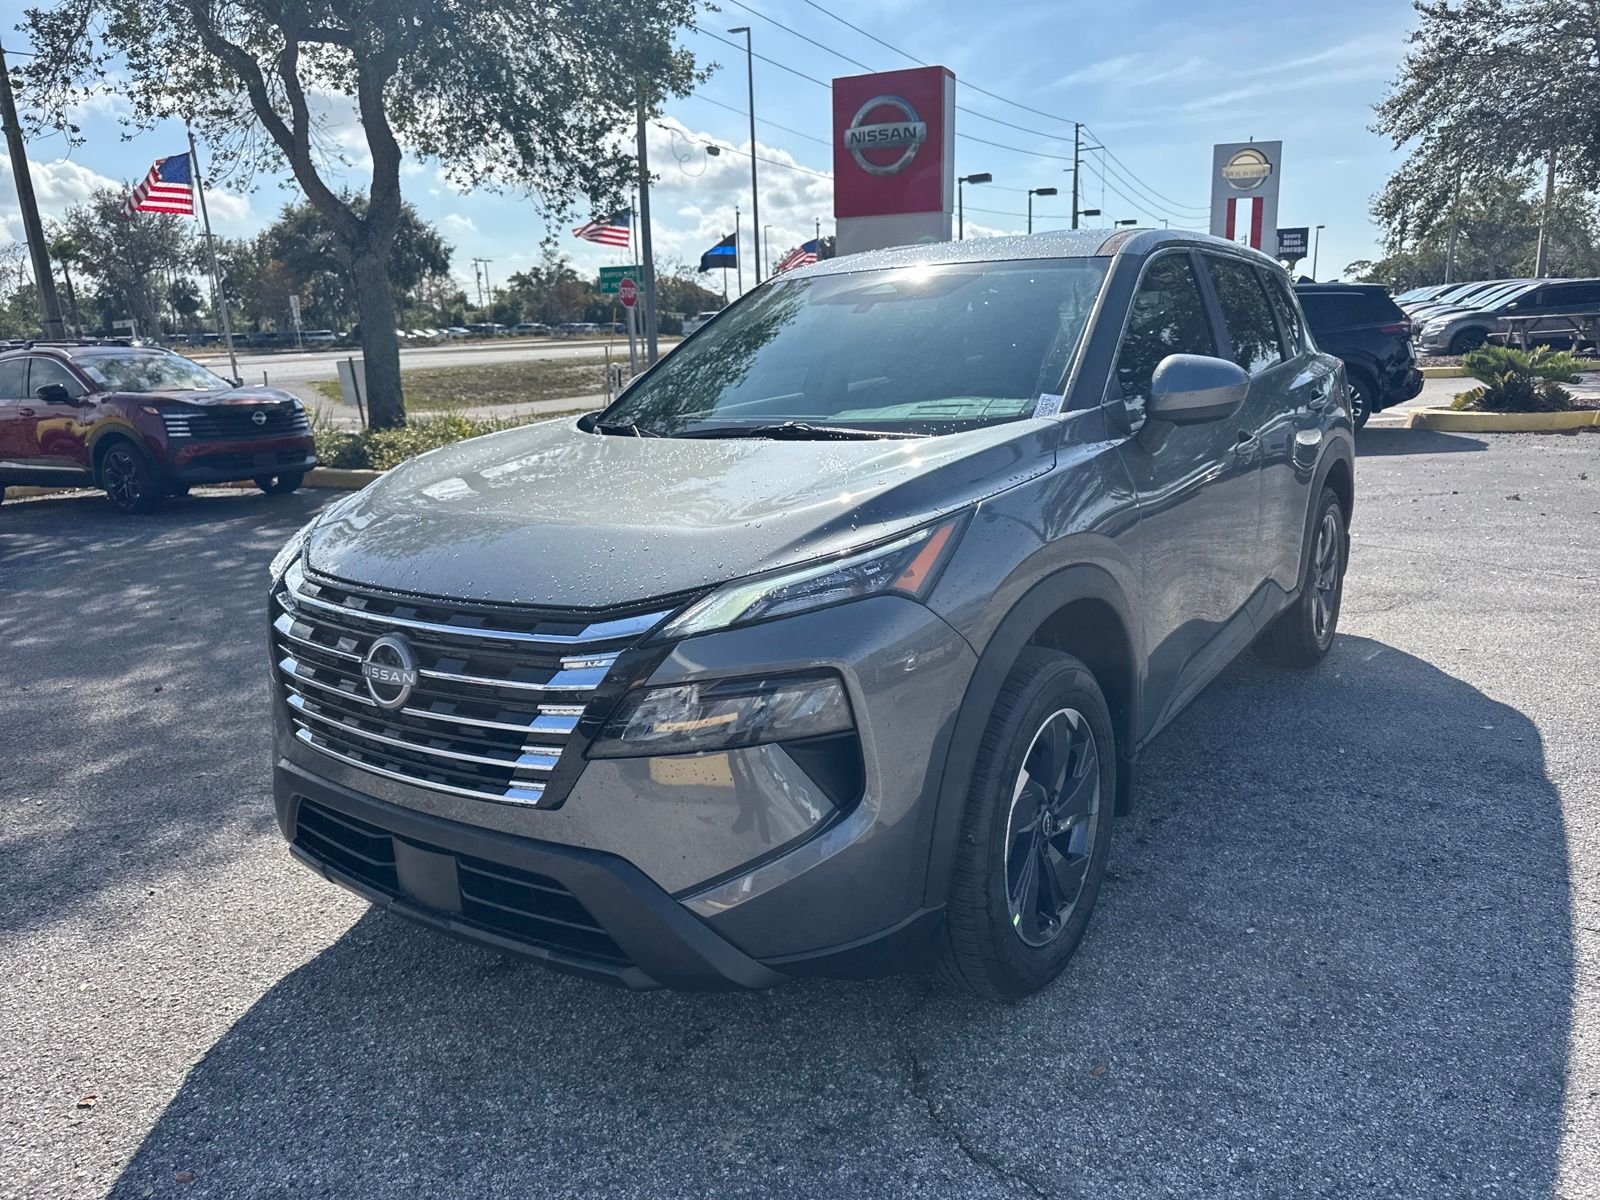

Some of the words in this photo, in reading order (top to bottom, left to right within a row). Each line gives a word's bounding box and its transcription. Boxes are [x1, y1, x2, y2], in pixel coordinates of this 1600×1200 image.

[850, 126, 917, 145] NISSAN
[1279, 246, 1306, 254] Storage
[620, 287, 636, 298] STOP
[362, 663, 414, 683] NISSAN
